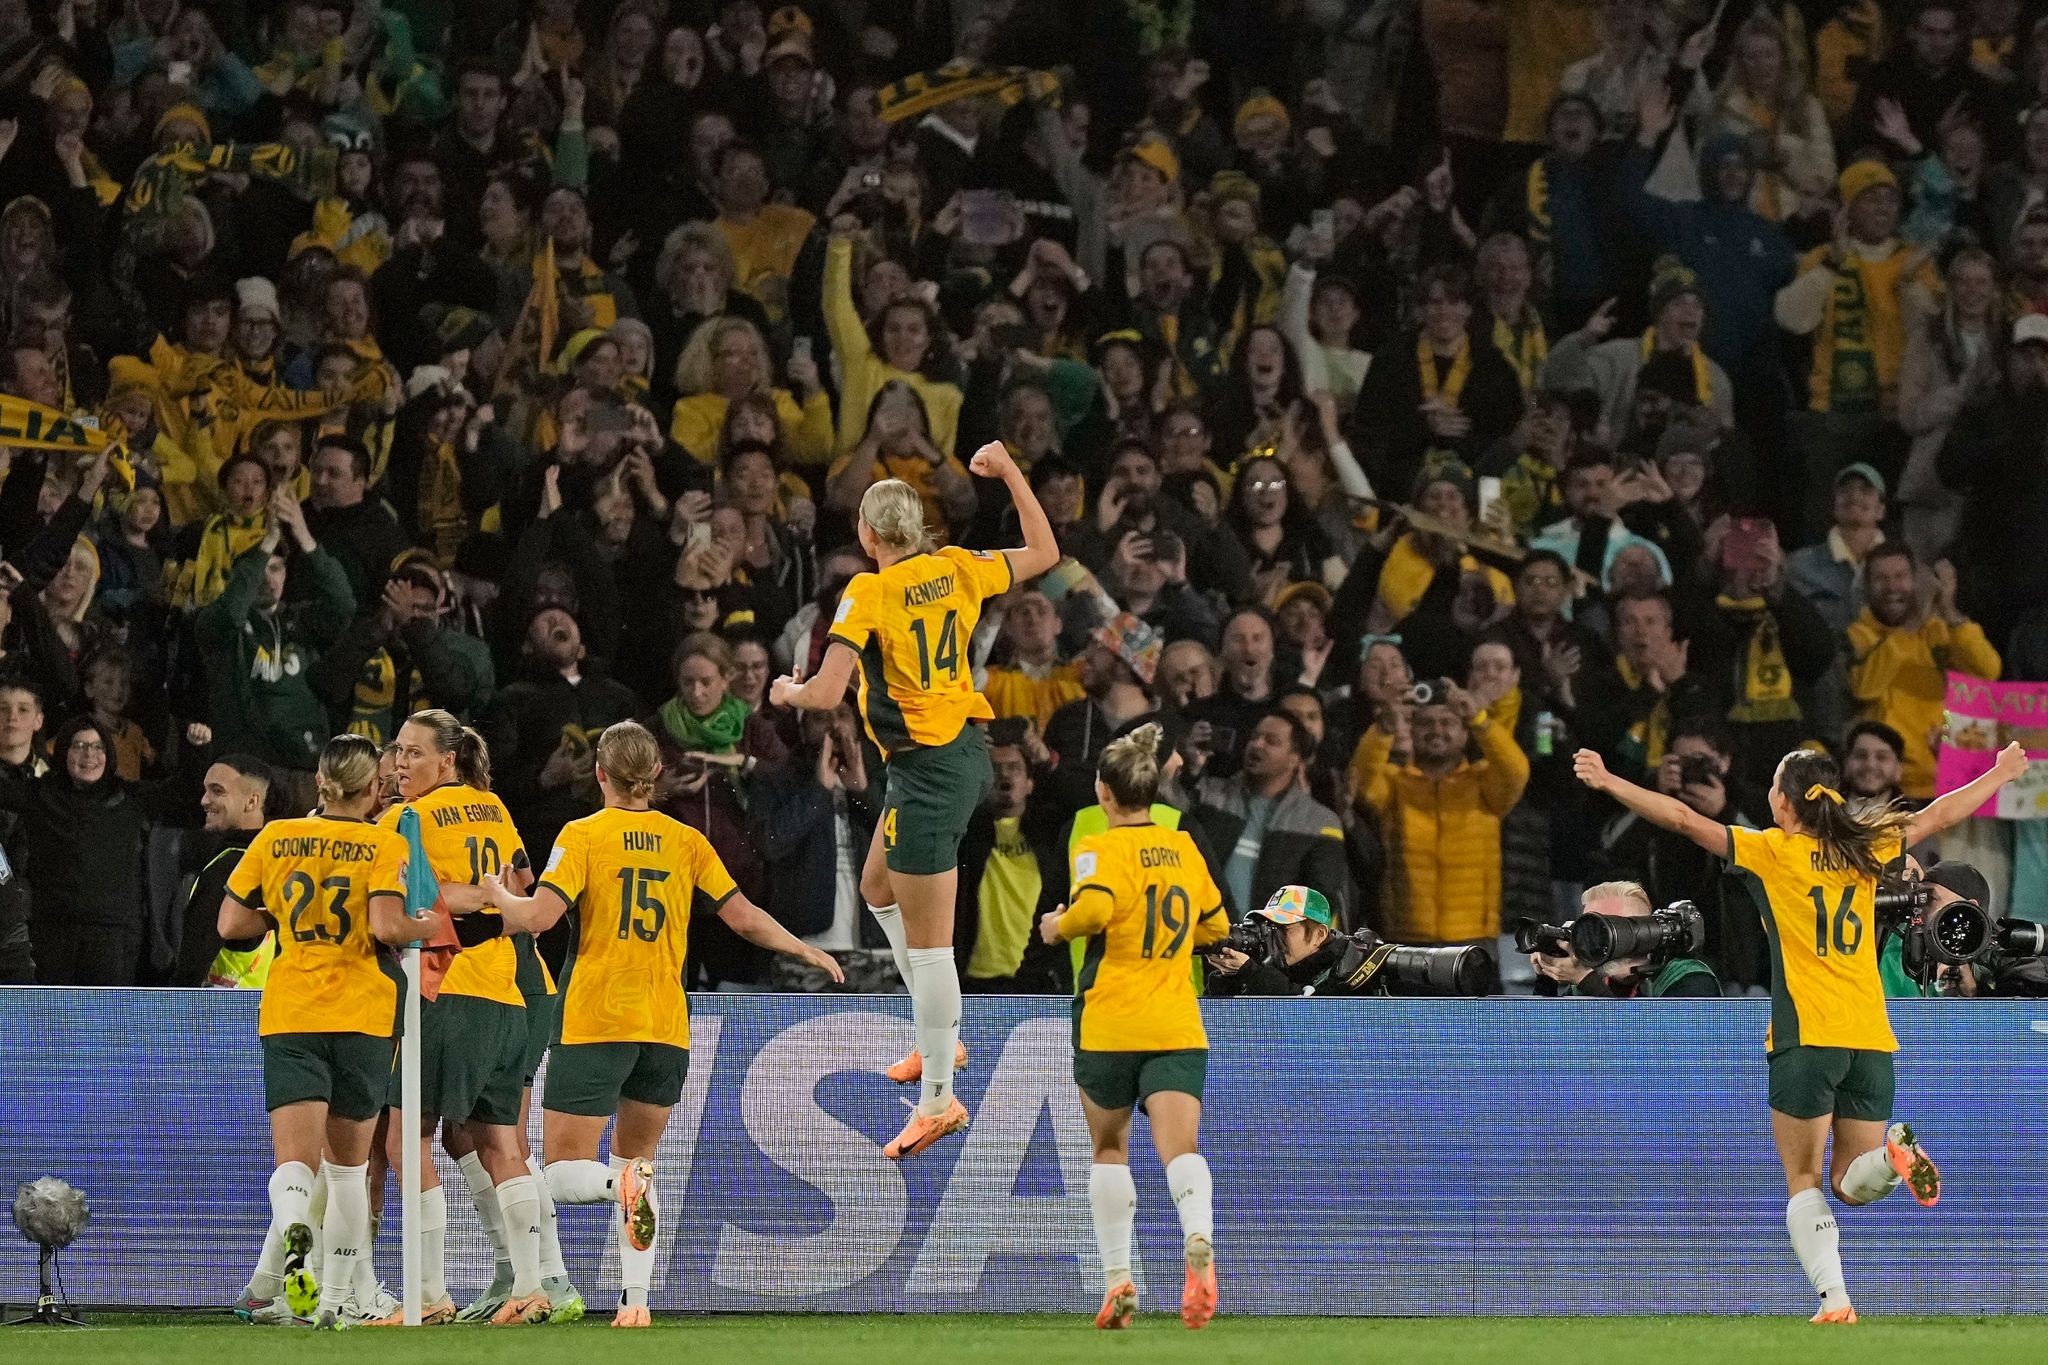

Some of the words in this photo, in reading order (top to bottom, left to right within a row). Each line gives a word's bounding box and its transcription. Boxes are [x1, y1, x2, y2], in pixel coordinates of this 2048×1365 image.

[904, 573, 955, 607] KENNEDY
[909, 609, 958, 690] 14
[431, 806, 462, 828] VAN
[463, 803, 502, 823] EGMOND
[272, 837, 376, 862] COONEY-CROSS
[623, 831, 662, 853] HUNT
[464, 836, 501, 886] 10
[1140, 847, 1182, 868] GORRY
[1811, 851, 1850, 872] RA
[282, 870, 352, 945] 23
[616, 867, 671, 943] 15
[1141, 884, 1190, 959] 19
[1807, 883, 1863, 957] 16
[286, 1185, 309, 1198] AUS
[333, 1247, 359, 1257] AUS
